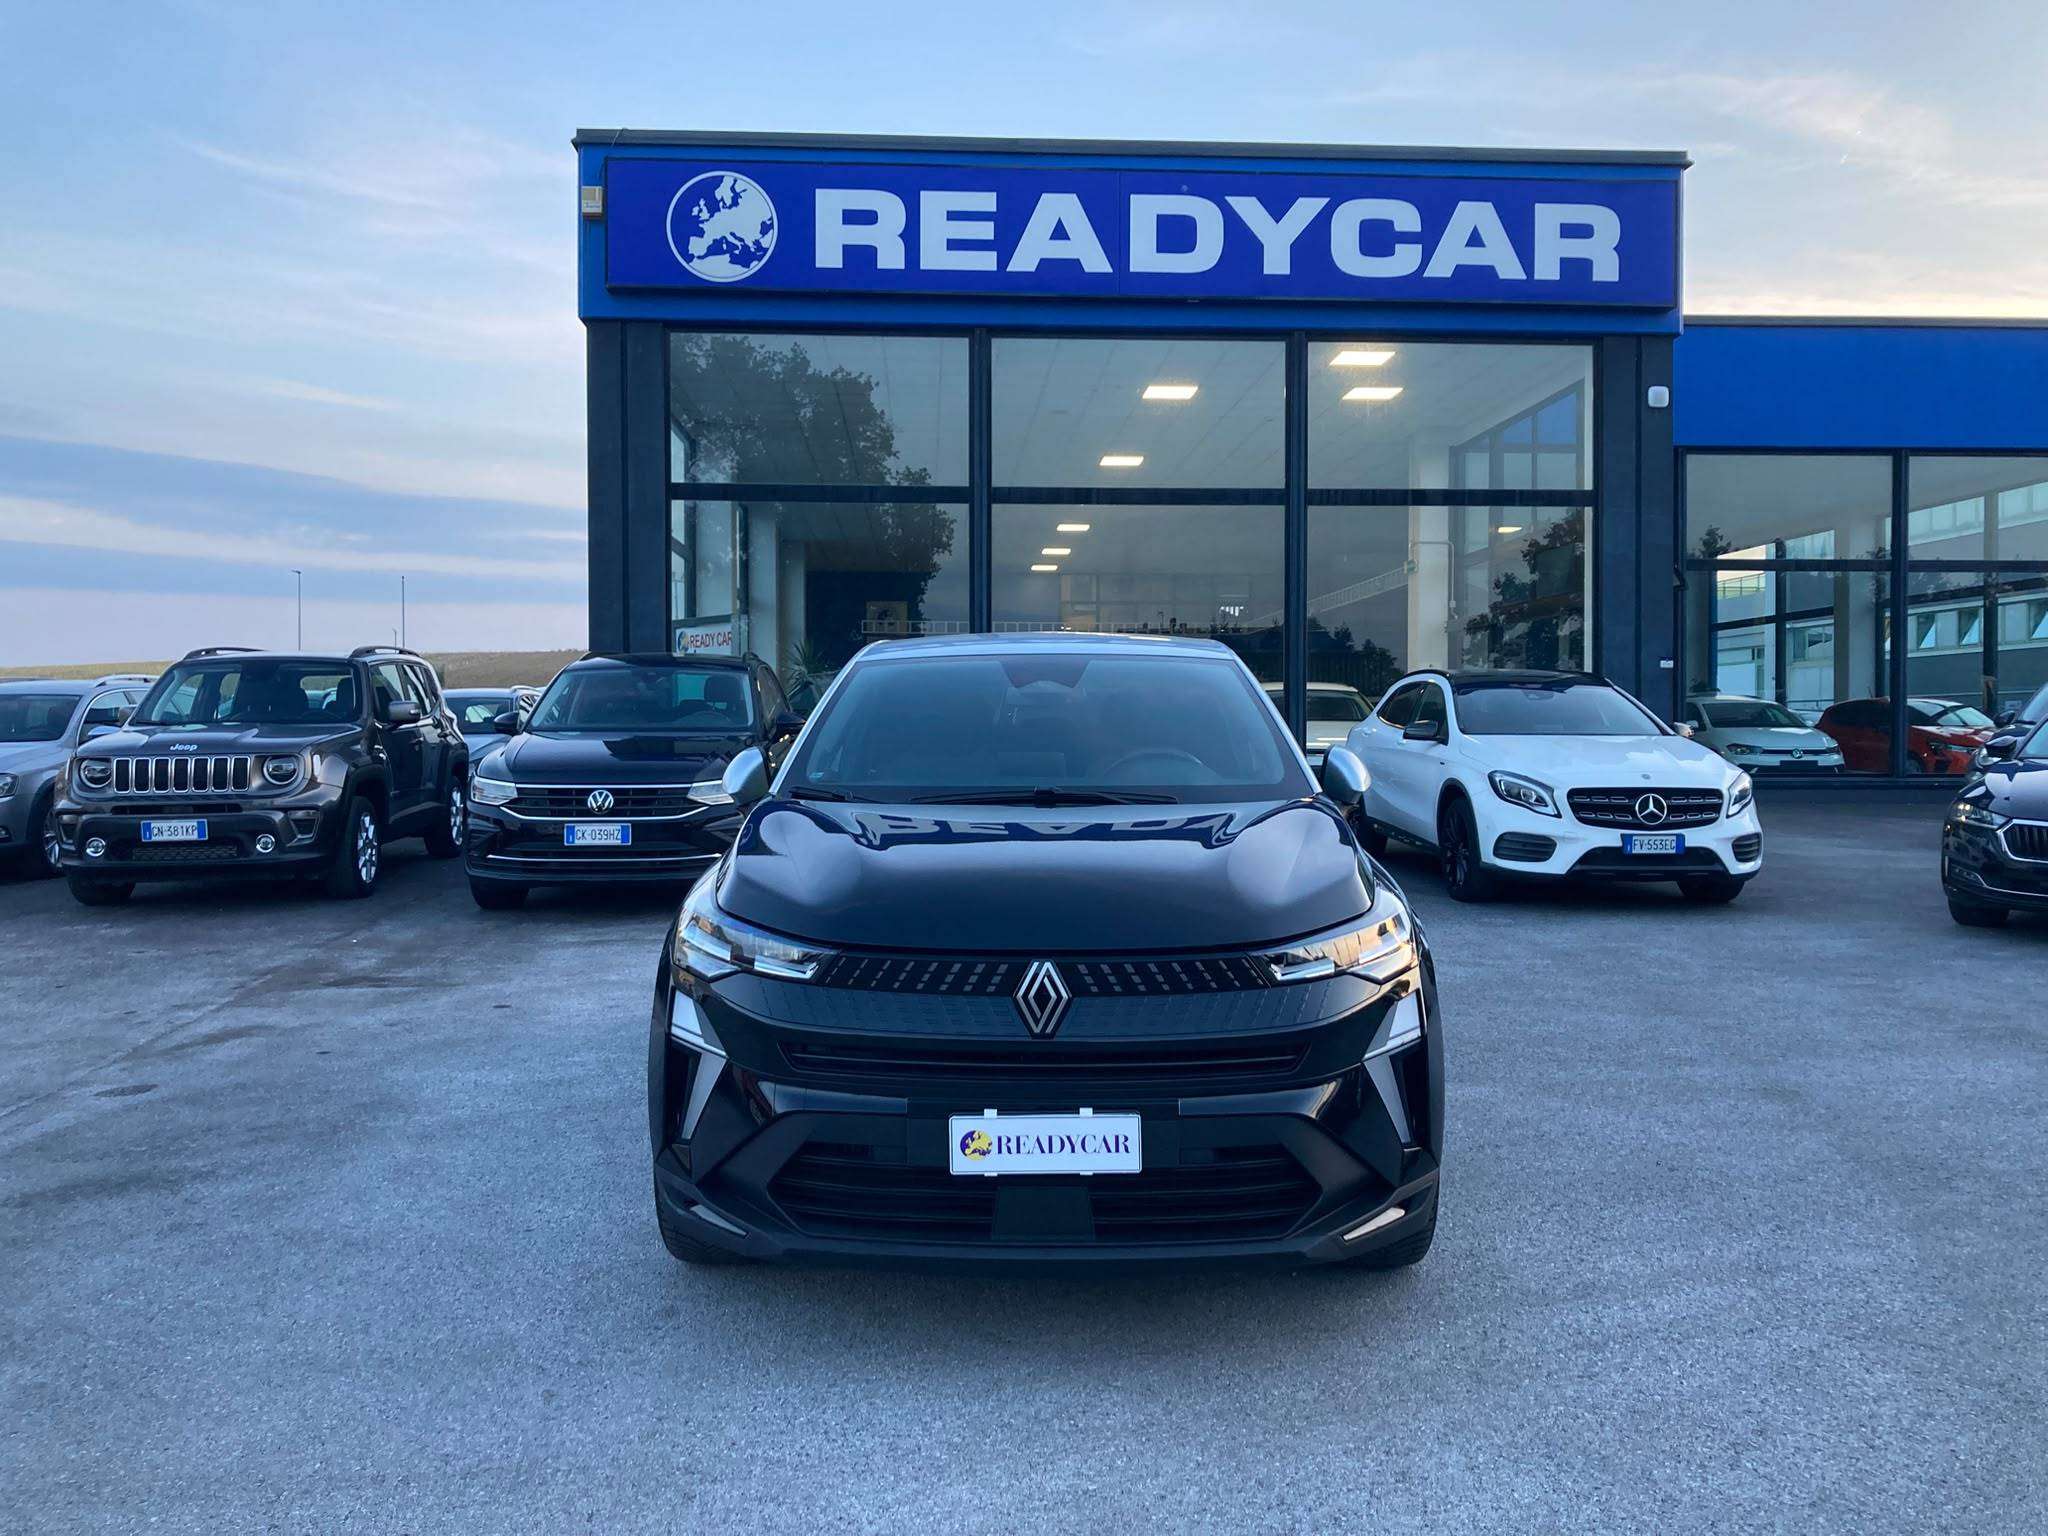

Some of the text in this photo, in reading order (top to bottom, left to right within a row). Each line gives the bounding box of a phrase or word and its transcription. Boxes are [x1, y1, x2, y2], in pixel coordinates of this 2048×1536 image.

[814, 187, 1622, 283] READYCAR
[689, 632, 716, 648] READY
[169, 743, 198, 751] Jeep
[996, 1134, 1131, 1156] READYCAR
